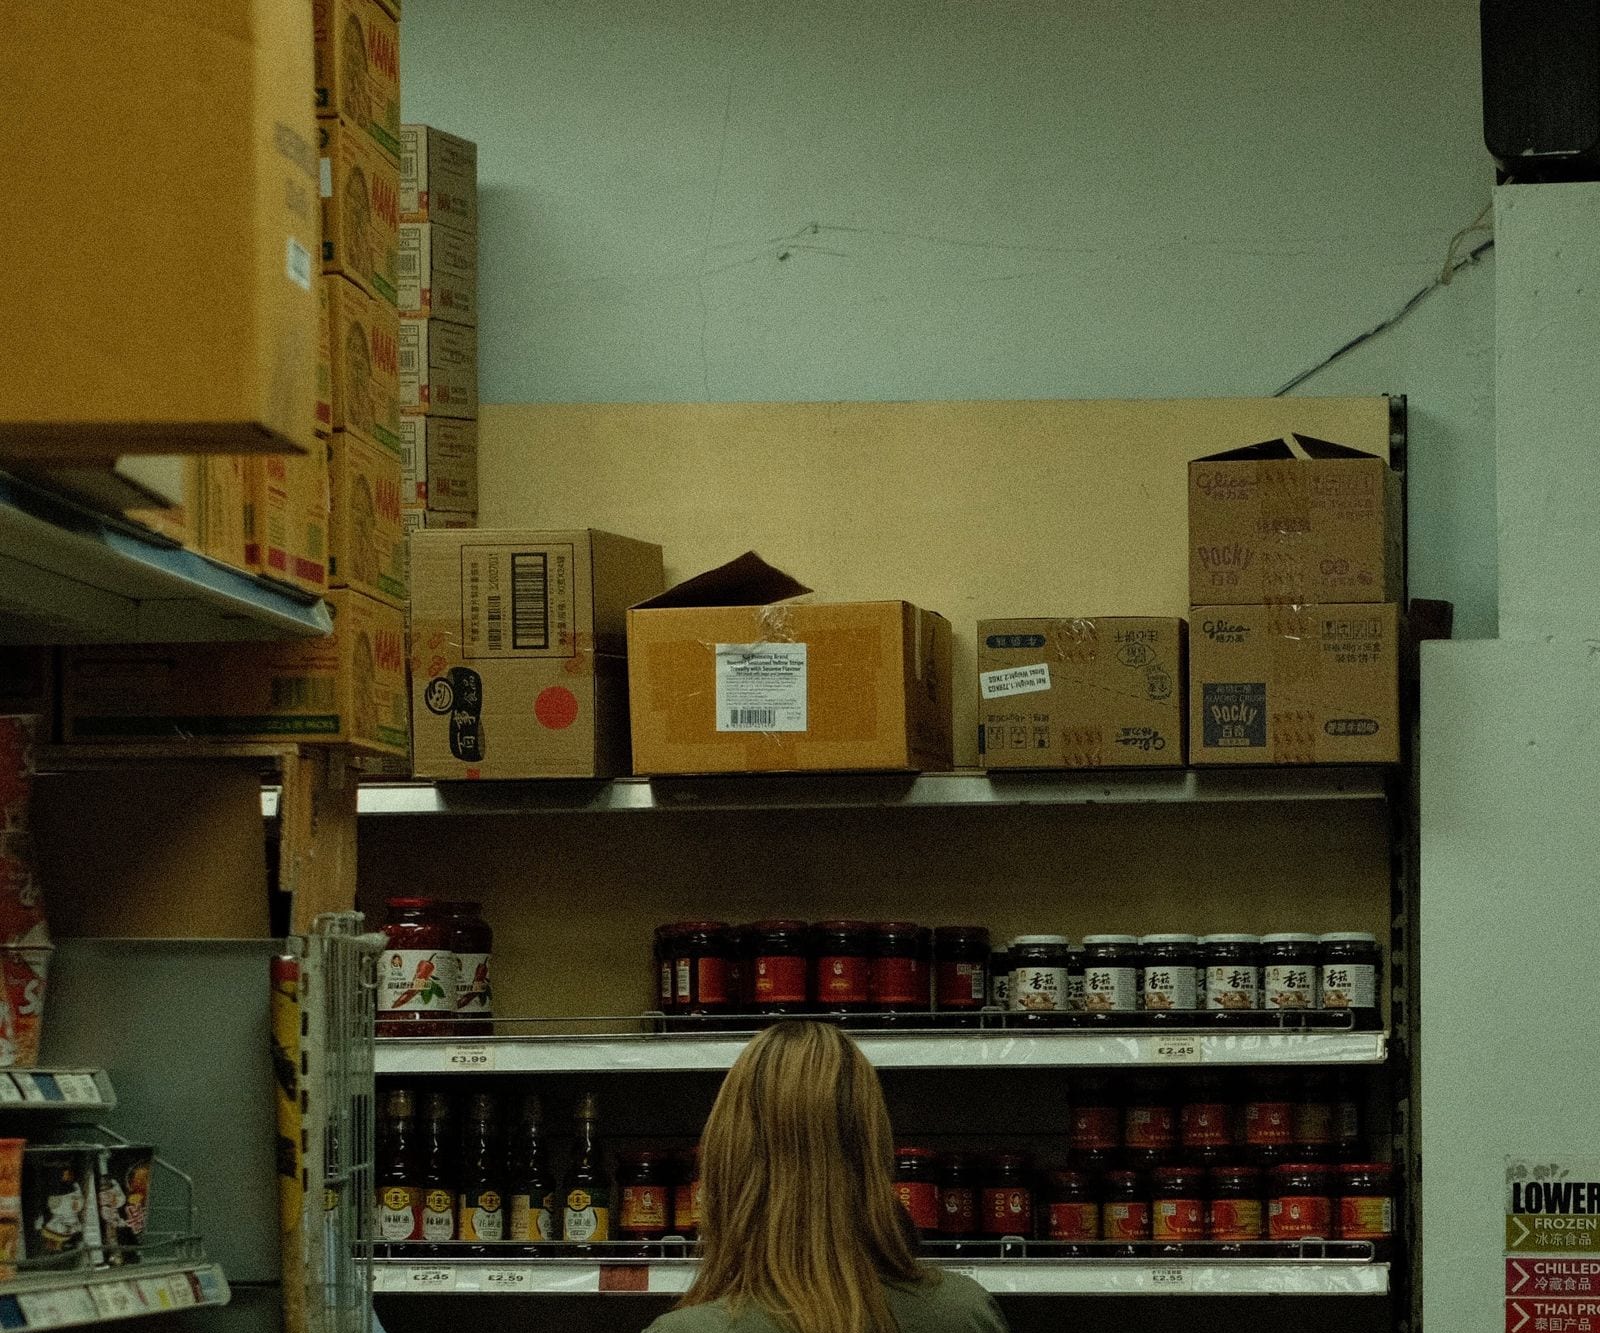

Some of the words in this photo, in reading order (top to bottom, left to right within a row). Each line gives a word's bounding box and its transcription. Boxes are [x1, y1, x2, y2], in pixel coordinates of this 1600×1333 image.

[1158, 1047, 1194, 1055] £2.45
[1512, 1182, 1600, 1214] LOWER
[1534, 1218, 1597, 1230] FROZEN
[1535, 1233, 1592, 1246] 冰冻食品
[1534, 1263, 1600, 1275] CHILLED
[413, 1273, 449, 1281] £2.45
[1534, 1277, 1592, 1291] 冷藏食品
[1534, 1303, 1573, 1315] THAI
[1535, 1318, 1592, 1332] 泰国产品
